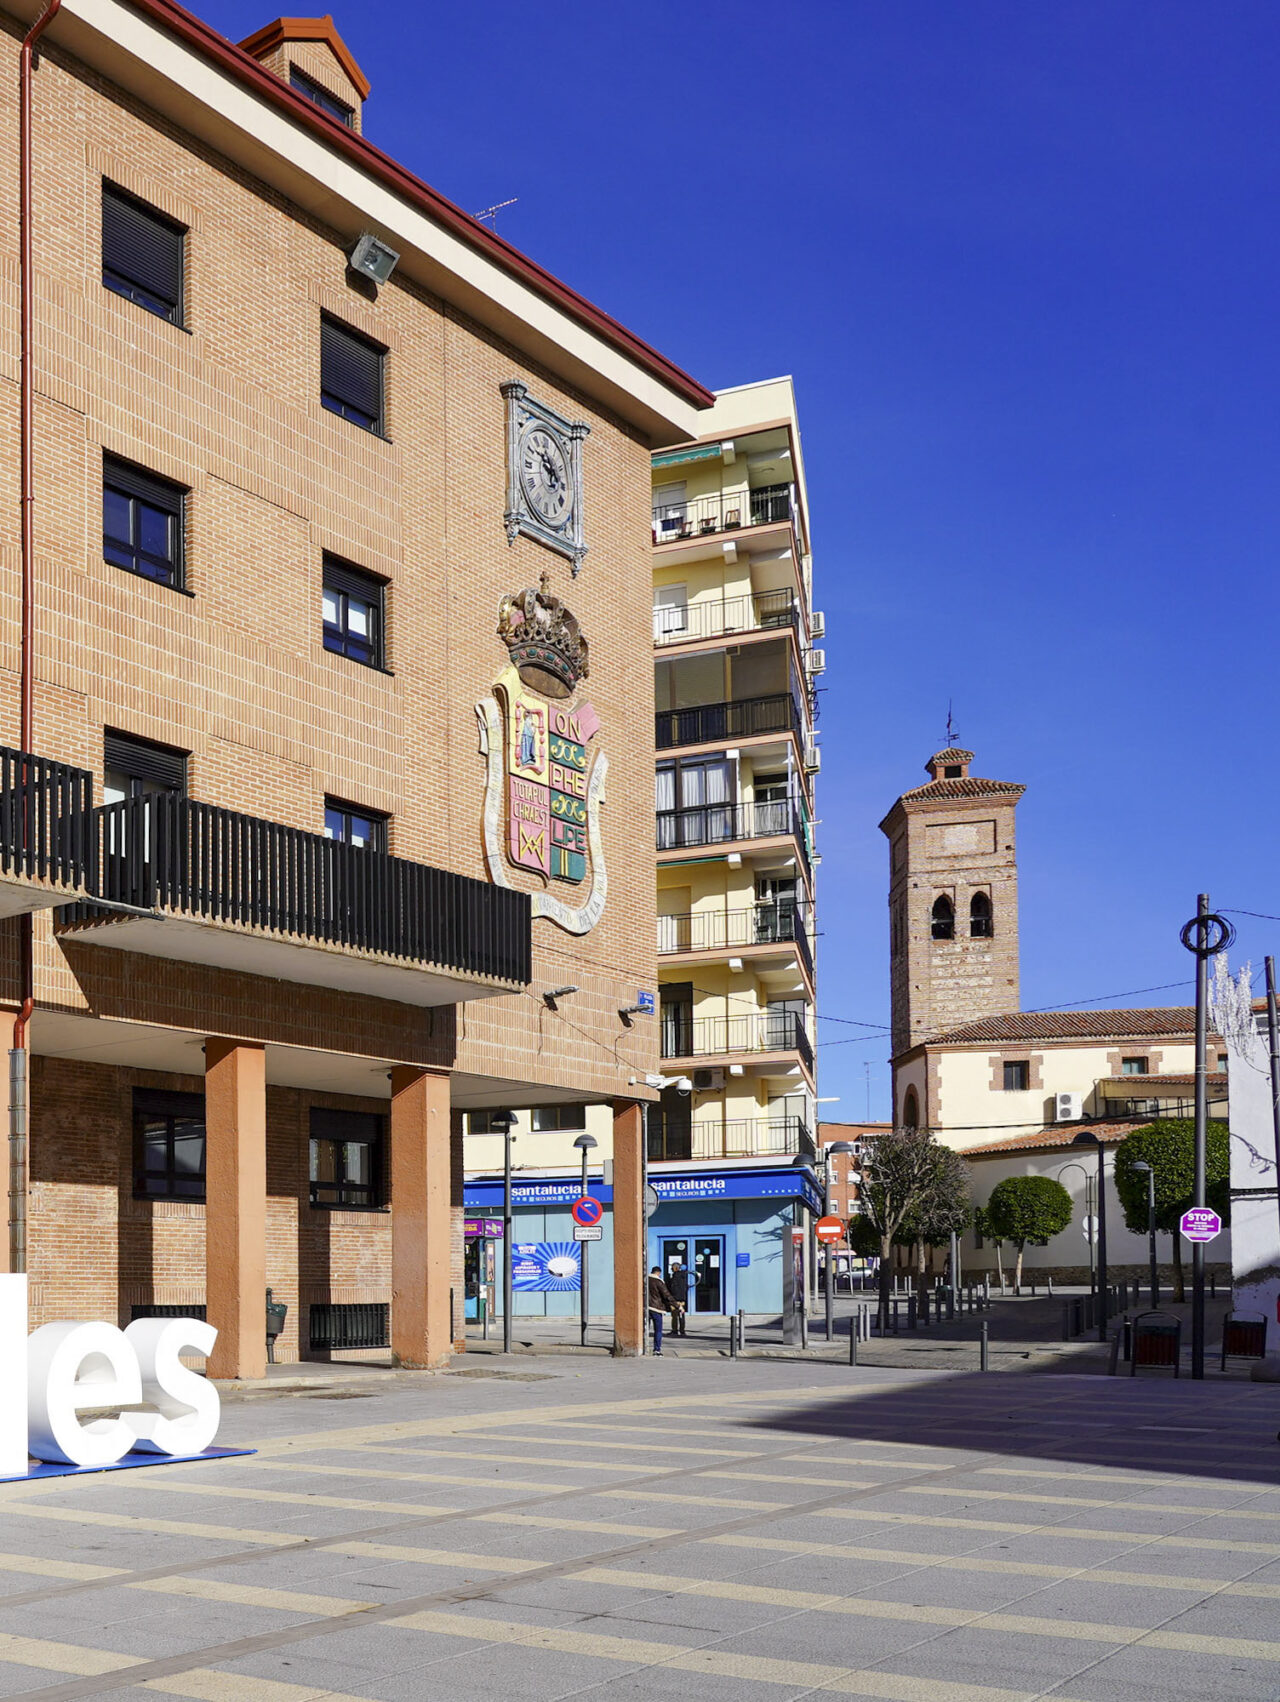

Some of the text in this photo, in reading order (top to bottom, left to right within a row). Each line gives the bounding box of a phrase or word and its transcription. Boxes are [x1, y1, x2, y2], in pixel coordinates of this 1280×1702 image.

[555, 713, 581, 742] ON
[551, 763, 586, 798] PHE
[553, 820, 587, 852] LPE
[1187, 1213, 1215, 1222] STOP
